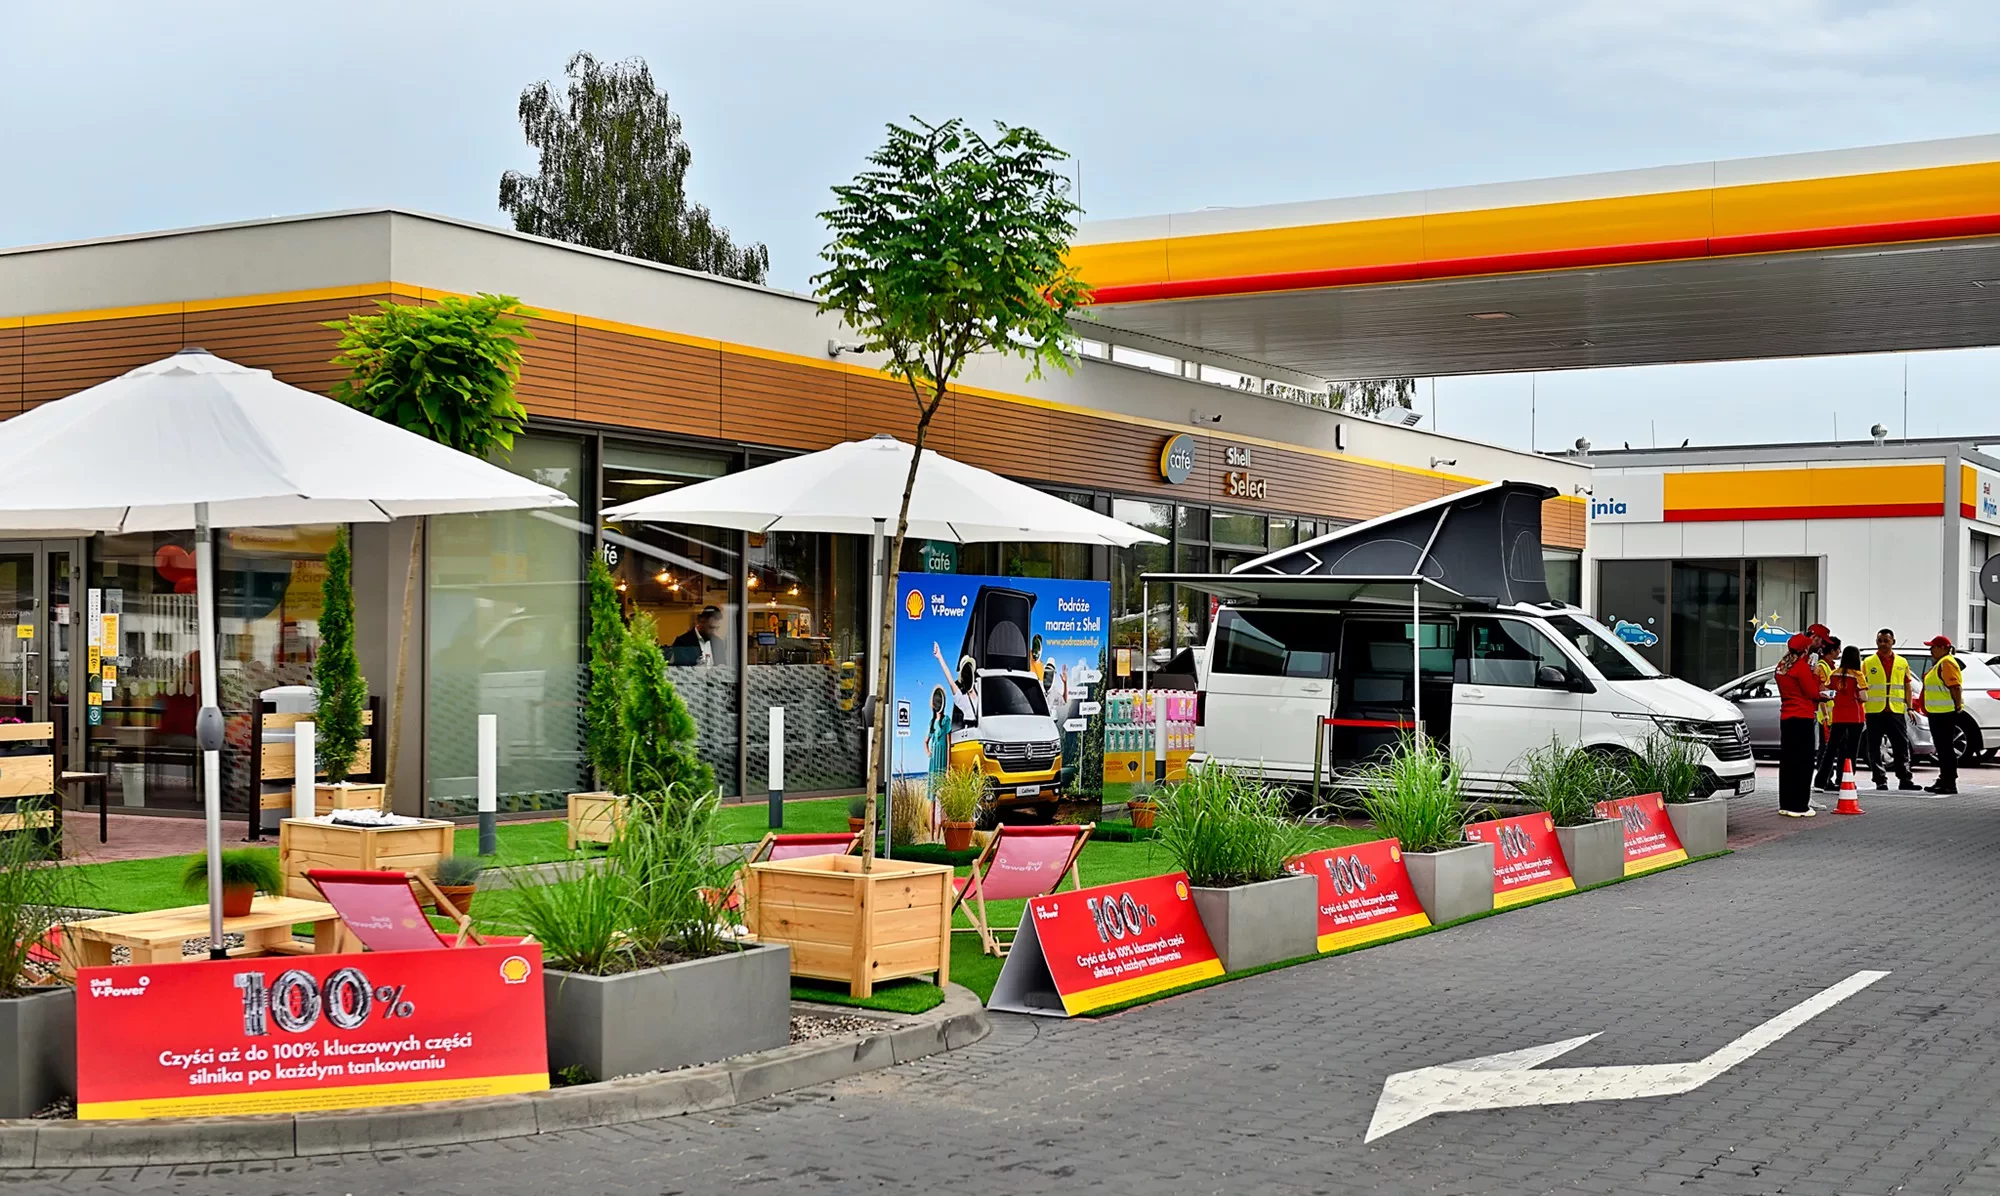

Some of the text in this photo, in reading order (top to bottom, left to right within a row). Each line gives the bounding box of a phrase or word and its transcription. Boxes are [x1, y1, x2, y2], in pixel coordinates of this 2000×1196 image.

[1170, 450, 1191, 470] café
[1228, 447, 1251, 467] Shell
[1230, 472, 1267, 499] Select
[1591, 498, 1627, 519] jnia
[601, 543, 618, 565] fé
[928, 552, 950, 570] café
[931, 594, 945, 604] Shell
[1058, 597, 1090, 612] Podróże
[931, 605, 965, 617] V-Power
[1045, 617, 1101, 632] marzeń z Shell
[1324, 854, 1377, 896] 100%
[1087, 892, 1157, 943] 100%
[1077, 934, 1185, 968] Czyści aż do 100% kluczowych części
[1093, 949, 1182, 979] silnika po każdym tankowaniu
[90, 977, 112, 987] Shell
[90, 986, 146, 998] V-Power
[233, 966, 415, 1037] 100%
[158, 1032, 473, 1069] Czyści aż do 100% kluczowych części
[189, 1055, 446, 1085] silnika po każdym tankowaniu
